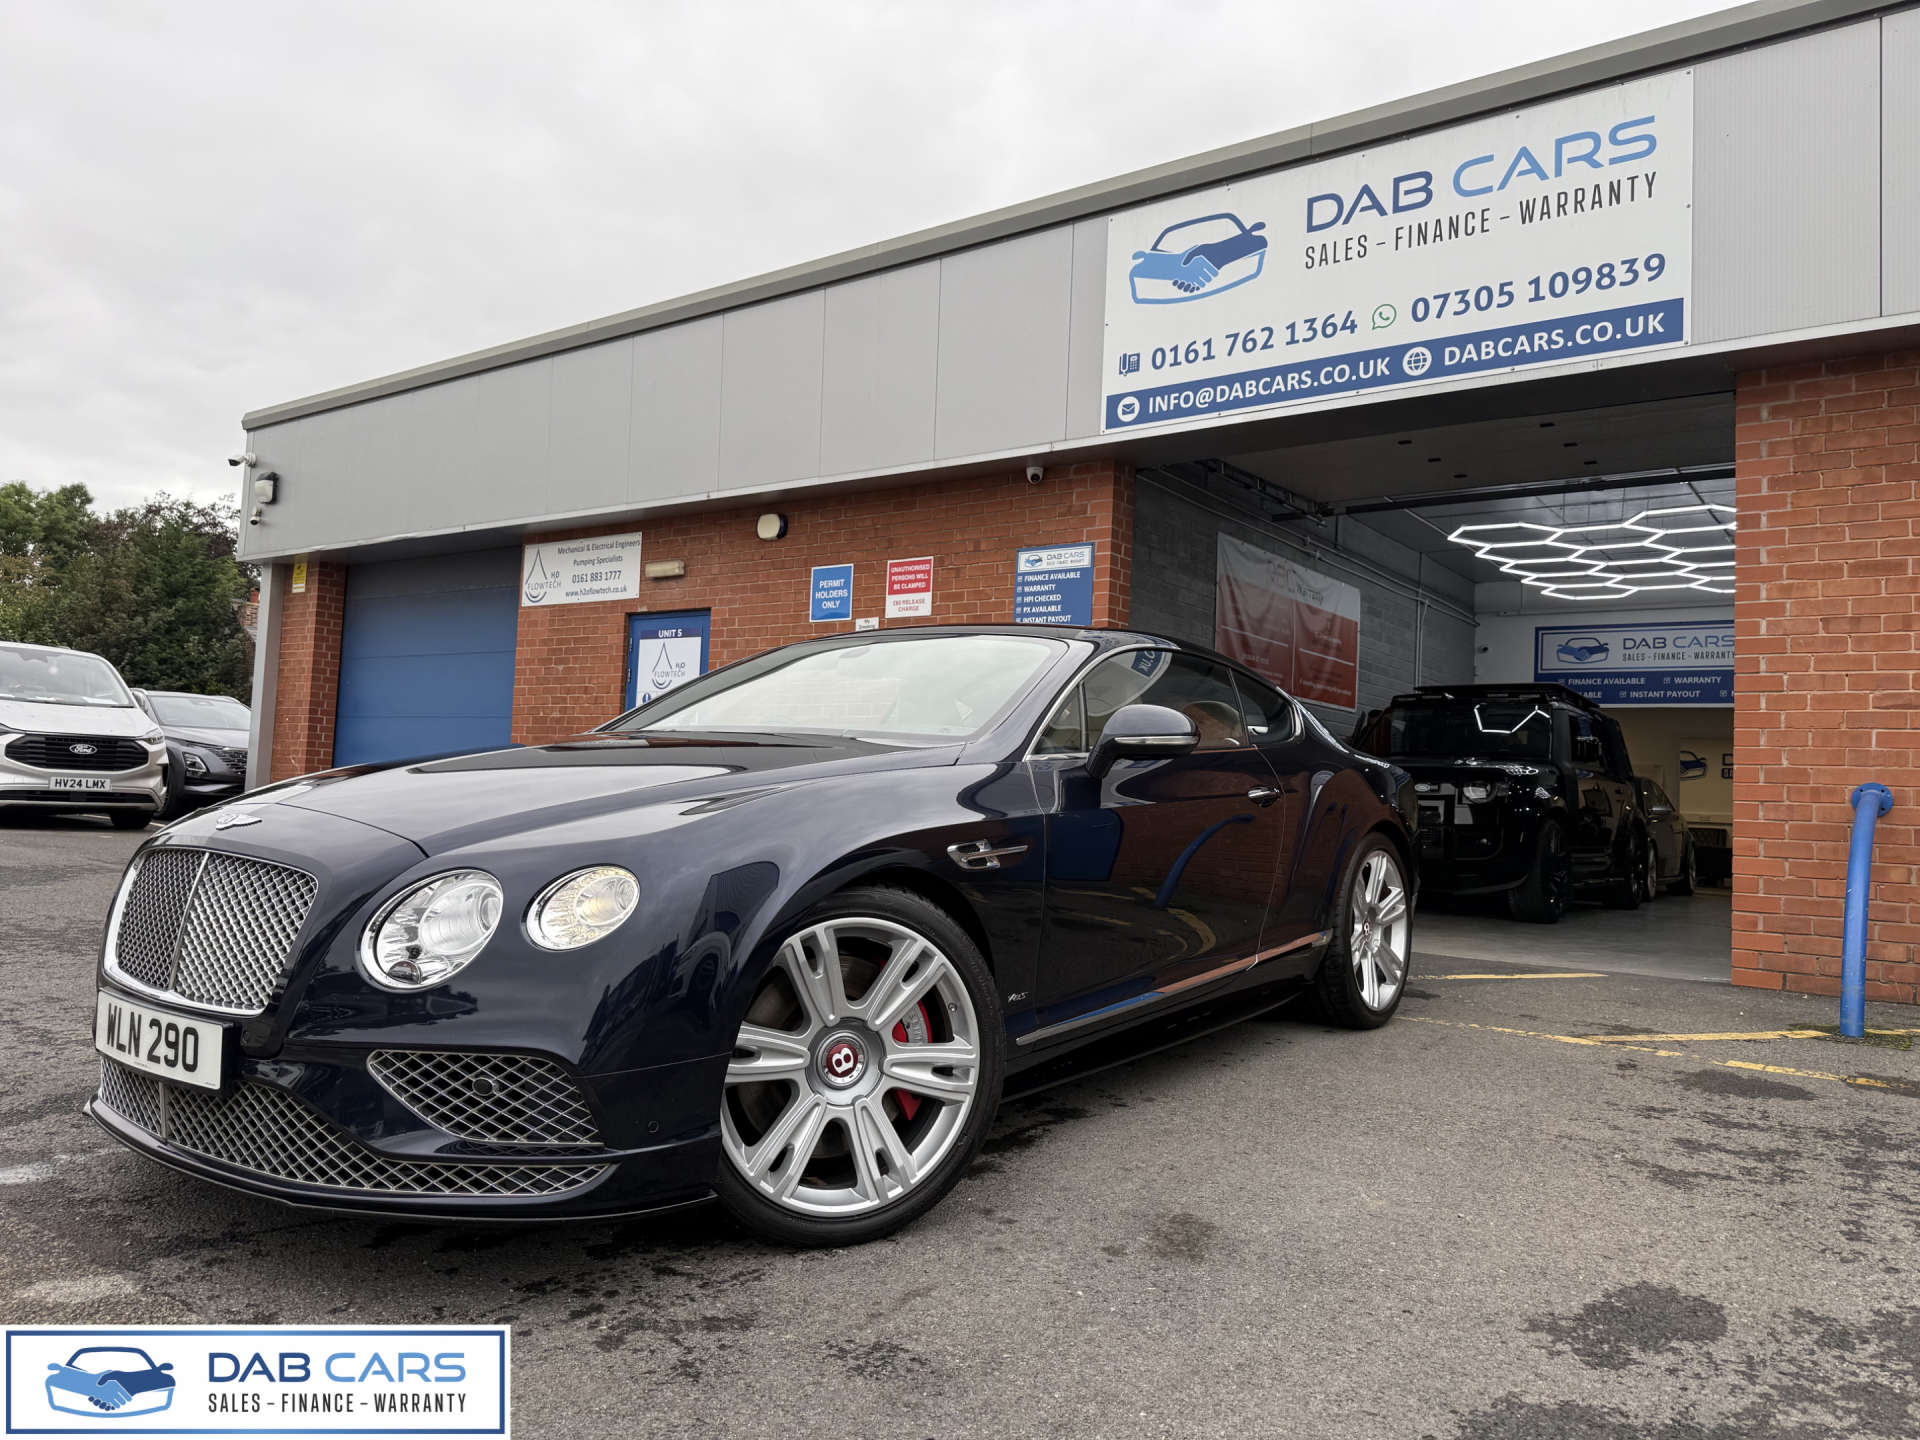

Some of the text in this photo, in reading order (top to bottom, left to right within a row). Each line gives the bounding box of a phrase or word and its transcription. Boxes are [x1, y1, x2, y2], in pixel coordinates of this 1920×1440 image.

[1306, 115, 1658, 234] DAB CARS
[1304, 233, 1370, 270] SALES
[1394, 207, 1492, 252] FINANCE
[1518, 171, 1658, 227] WARRANTY
[1151, 252, 1667, 372] 0161 762 1364 07305 109839
[1147, 311, 1665, 415] INFO@DABCARS.CO.UK DABCARS.CO.UK
[557, 544, 585, 554] Mechanical
[592, 541, 614, 551] Electrical
[615, 539, 640, 549] Engineers
[1063, 551, 1085, 559] CARS
[573, 555, 623, 567] Pumping Specialists
[572, 573, 588, 584] 0161
[604, 570, 621, 580] 1777
[1024, 571, 1080, 582] FINANCE AVAILABLE
[527, 580, 561, 591] FLOWTECH
[819, 578, 845, 588] PERMIT
[1024, 584, 1056, 592] WARRANTY
[815, 589, 848, 599] HOLDERS
[1035, 594, 1062, 602] CHECKED
[822, 600, 840, 609] ONLY
[1032, 604, 1062, 612] AVAILABLE
[1047, 614, 1072, 623] PAYOUT
[658, 629, 682, 638] UNIT 5
[1623, 635, 1735, 650] DAB CARS
[1622, 652, 1646, 662] SALES
[1653, 651, 1687, 661] FINANCE
[1567, 676, 1722, 685] FINANCE AVAILABLE WARRANTY
[1629, 690, 1665, 698] INSTANT
[1666, 690, 1701, 698] PAYOUT
[55, 778, 106, 789] HV24 LMX
[107, 1002, 199, 1073] WLN 290
